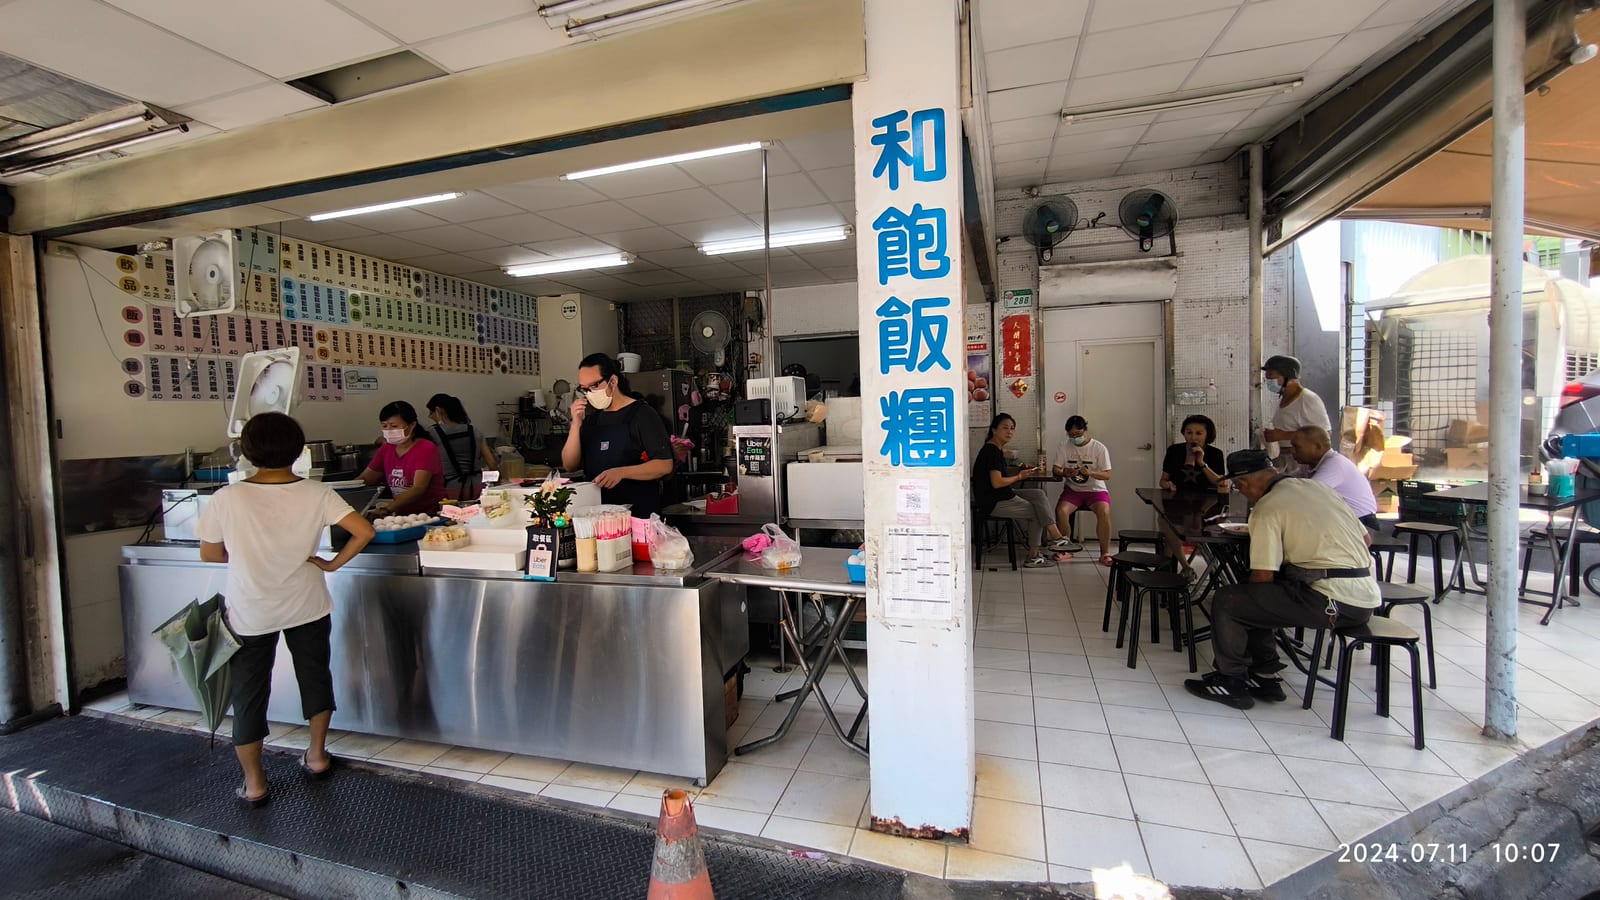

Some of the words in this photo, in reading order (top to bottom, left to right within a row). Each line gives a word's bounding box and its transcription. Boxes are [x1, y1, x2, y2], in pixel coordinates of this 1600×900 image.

[121, 259, 136, 291] 飲品
[870, 107, 955, 468] 和飽飯糰
[1014, 297, 1029, 305] 288
[126, 309, 141, 343] 飯糰
[316, 331, 328, 358] 吐司
